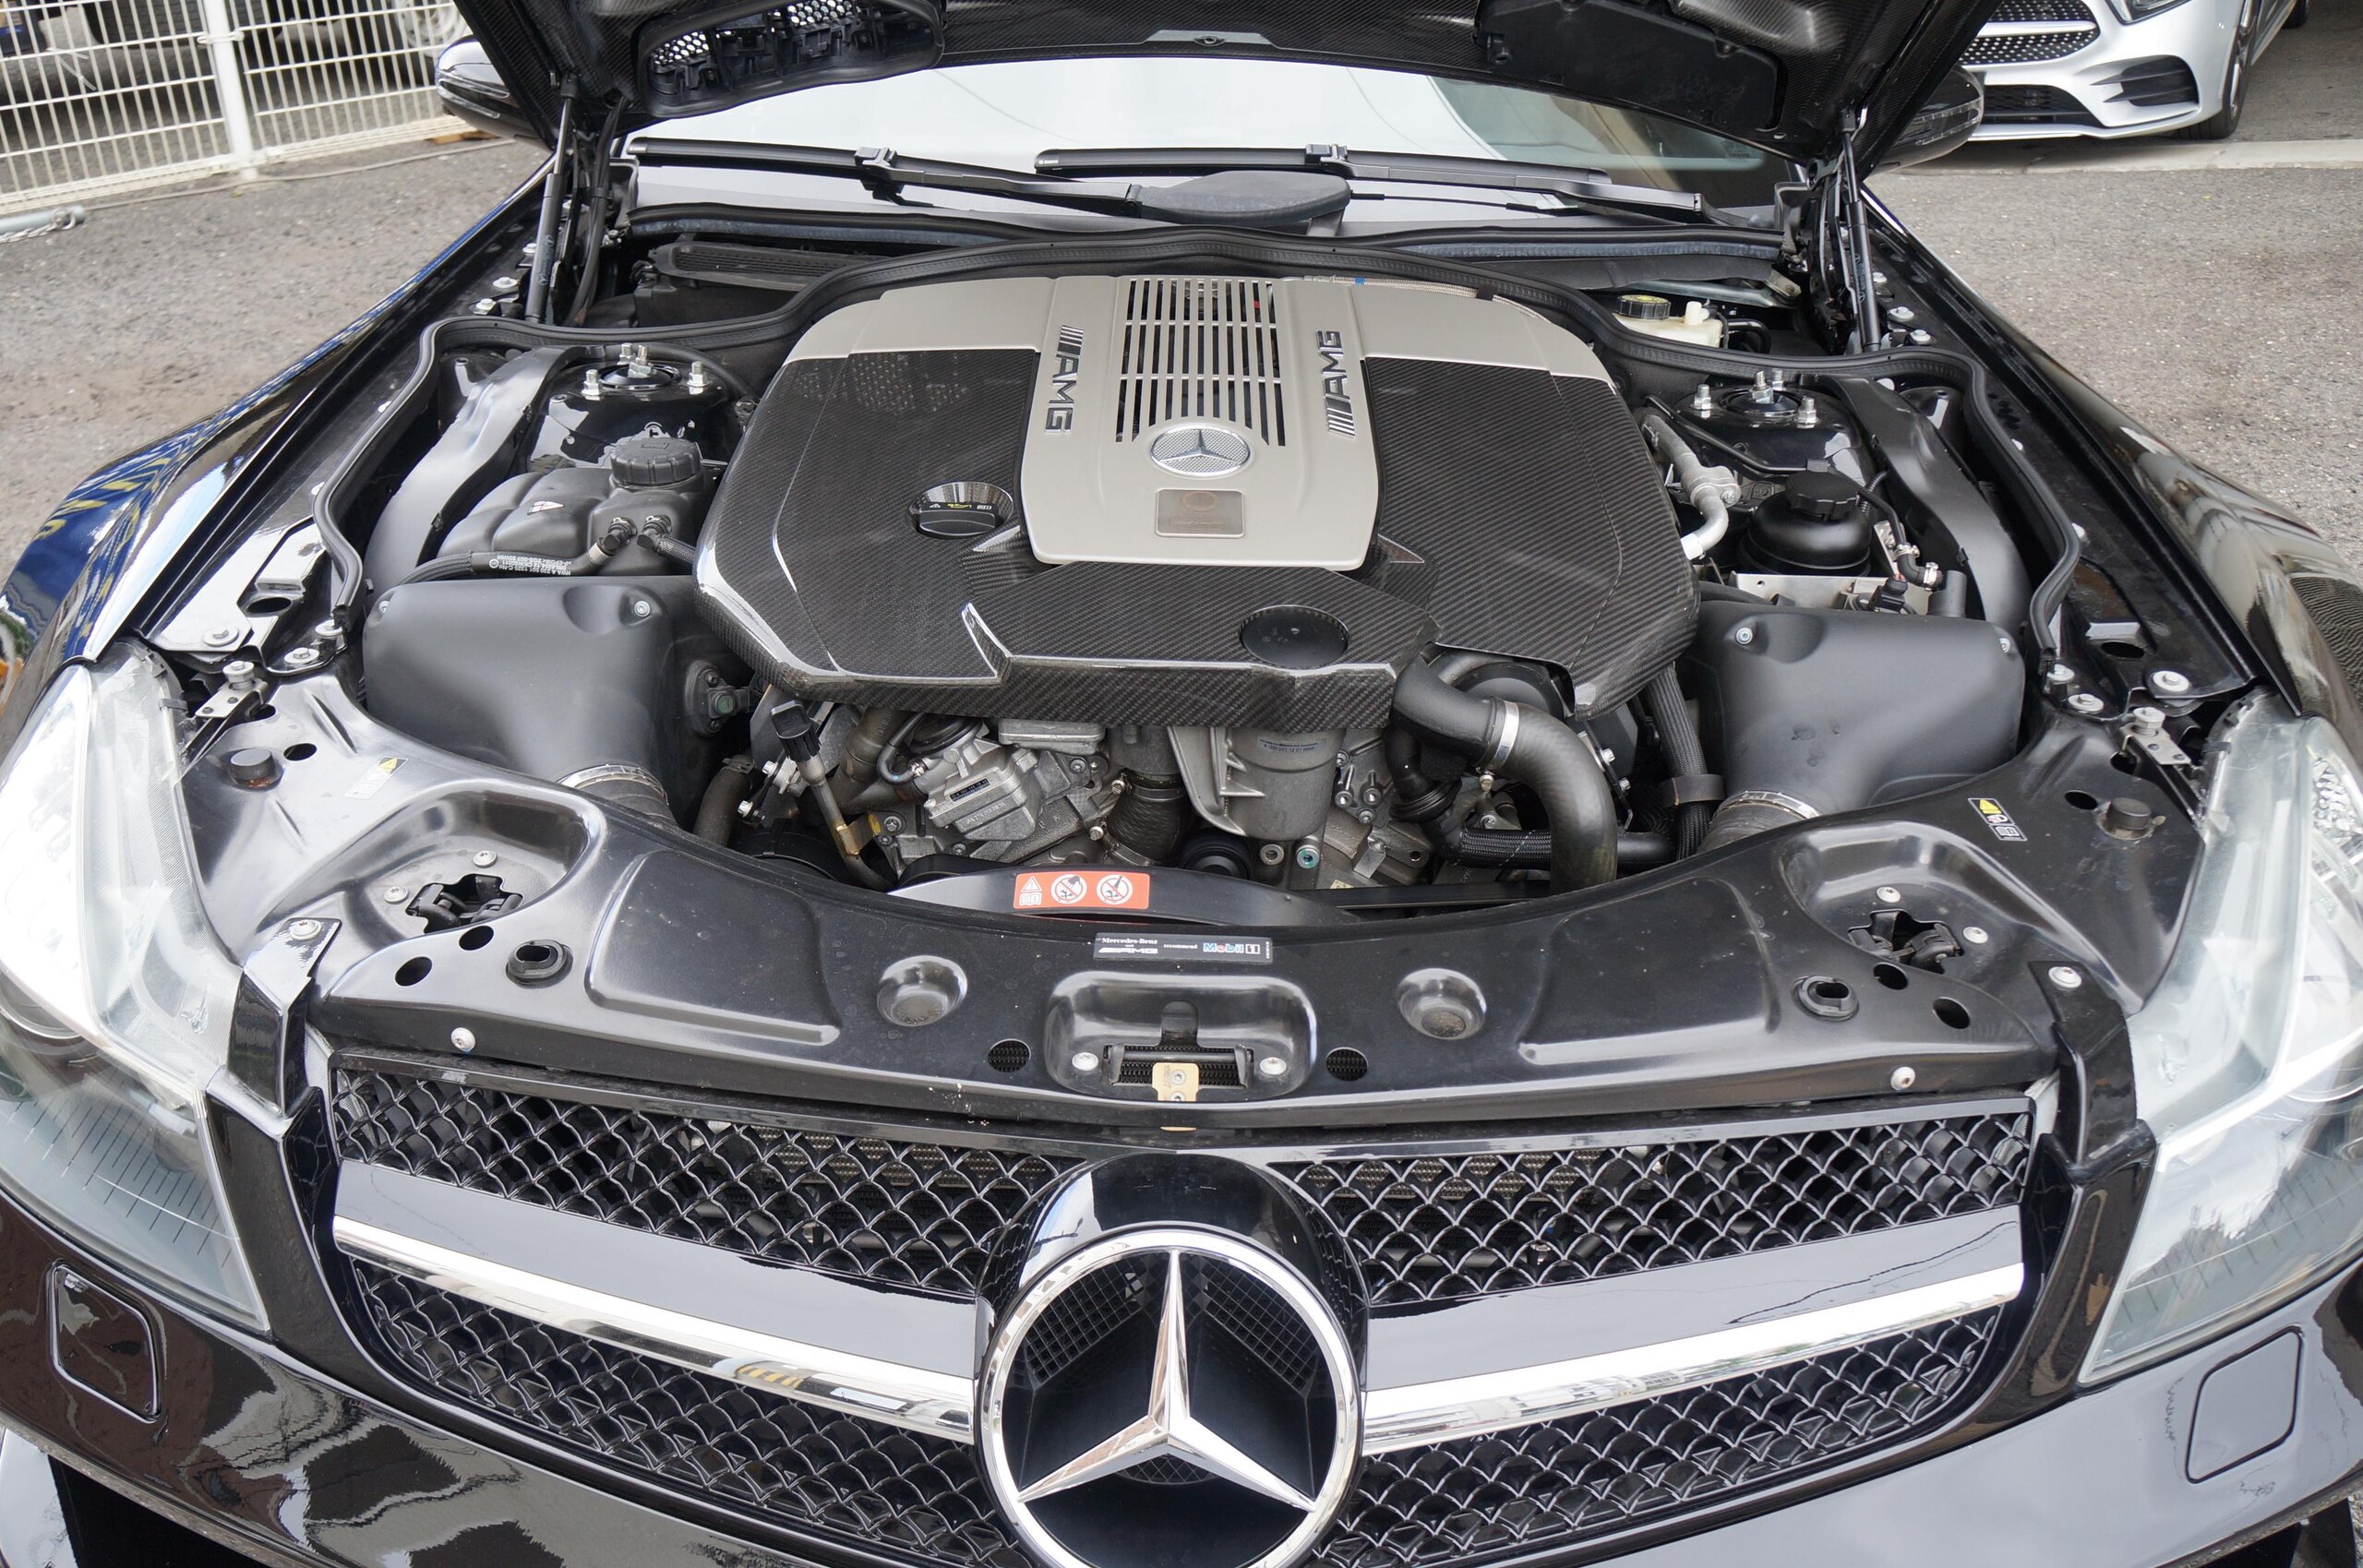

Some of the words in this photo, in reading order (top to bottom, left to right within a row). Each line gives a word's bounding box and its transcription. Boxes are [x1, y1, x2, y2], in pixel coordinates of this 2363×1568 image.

[1044, 352, 1080, 434] AMG
[1315, 329, 1349, 401] AMG
[1203, 941, 1244, 954] Mobil
